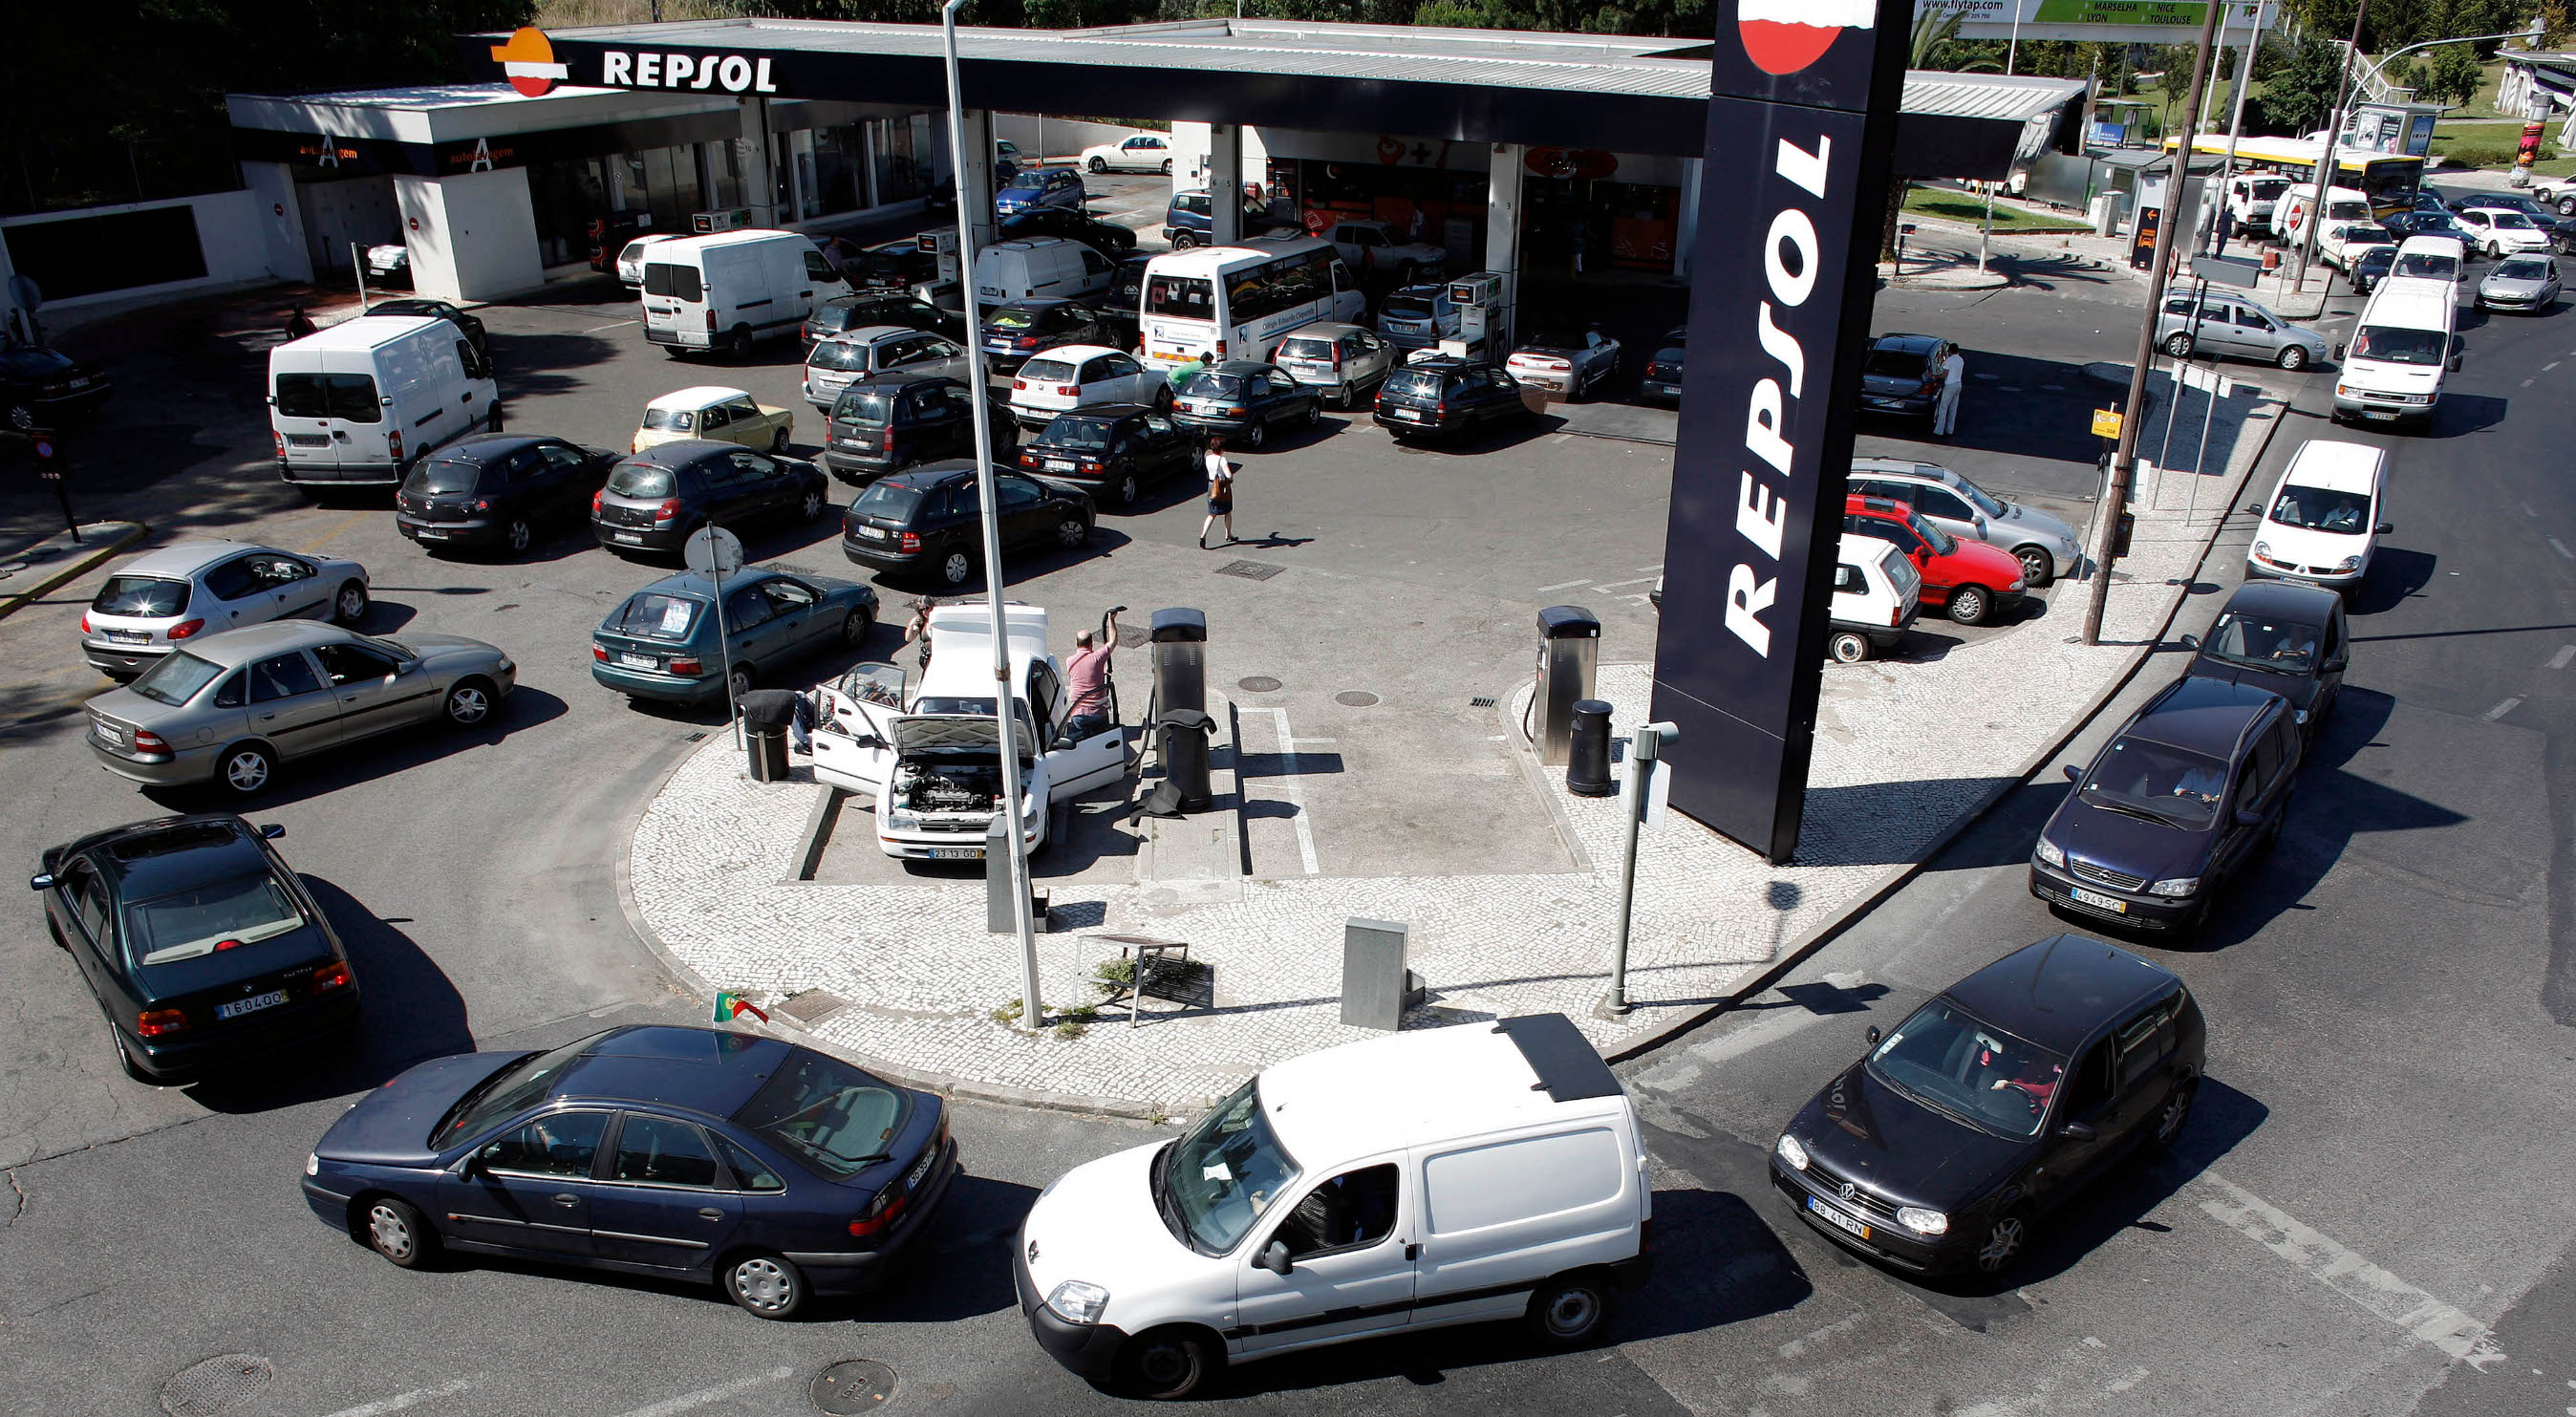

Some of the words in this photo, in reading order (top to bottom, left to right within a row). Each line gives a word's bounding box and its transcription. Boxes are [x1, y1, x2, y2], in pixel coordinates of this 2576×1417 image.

[2086, 13, 2108, 23] LYON
[2150, 14, 2192, 25] TOULOUSE
[2093, 3, 2137, 12] MARSELHA
[2157, 4, 2176, 12] NICE
[603, 51, 777, 93] REPSOL
[1725, 134, 1833, 659] REPSOL
